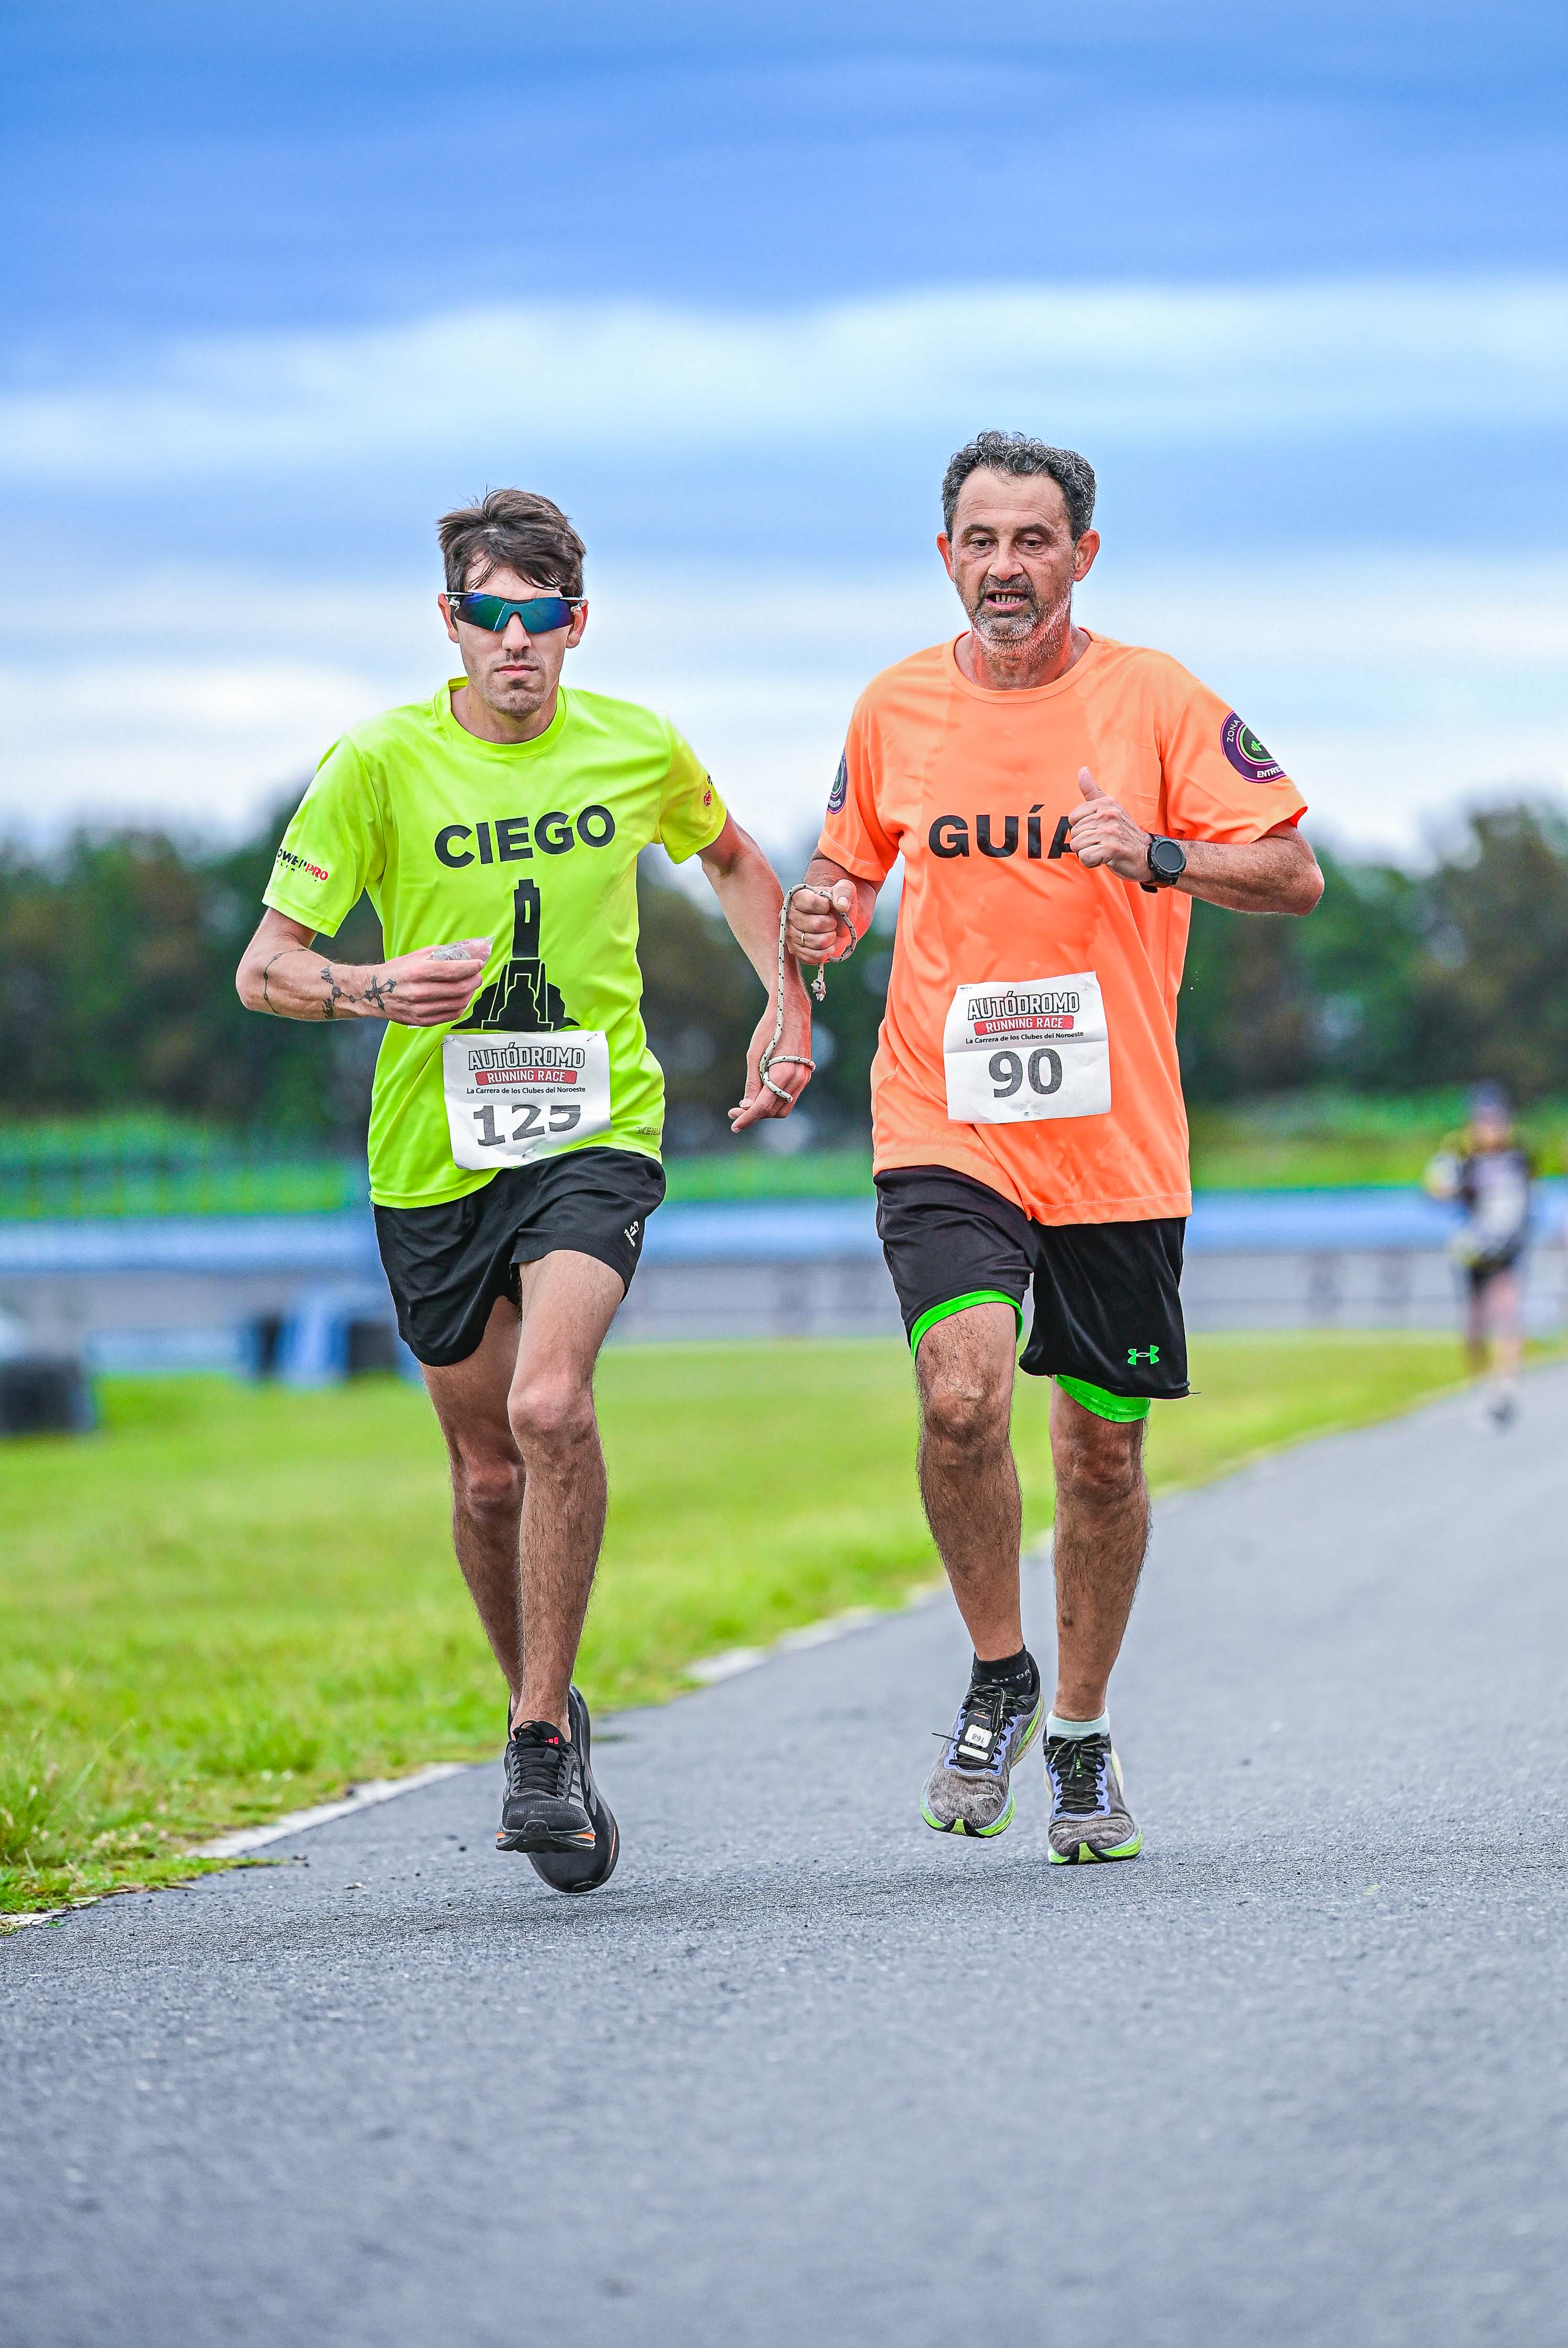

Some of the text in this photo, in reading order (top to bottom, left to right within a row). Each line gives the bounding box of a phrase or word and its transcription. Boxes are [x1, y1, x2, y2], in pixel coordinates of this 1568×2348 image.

[1227, 719, 1241, 742] ZONA
[435, 805, 615, 868] CIEGO
[928, 804, 1080, 859] GUÍA
[968, 991, 1080, 1020] AUTÓDROMO
[985, 1017, 1064, 1033] RUNNING RACE
[468, 1042, 585, 1071] AUTÓDROMO
[486, 1070, 566, 1083] RUNNING RACE
[989, 1048, 1062, 1098] 90
[473, 1104, 581, 1146] 125
[972, 1733, 985, 1744] 168
